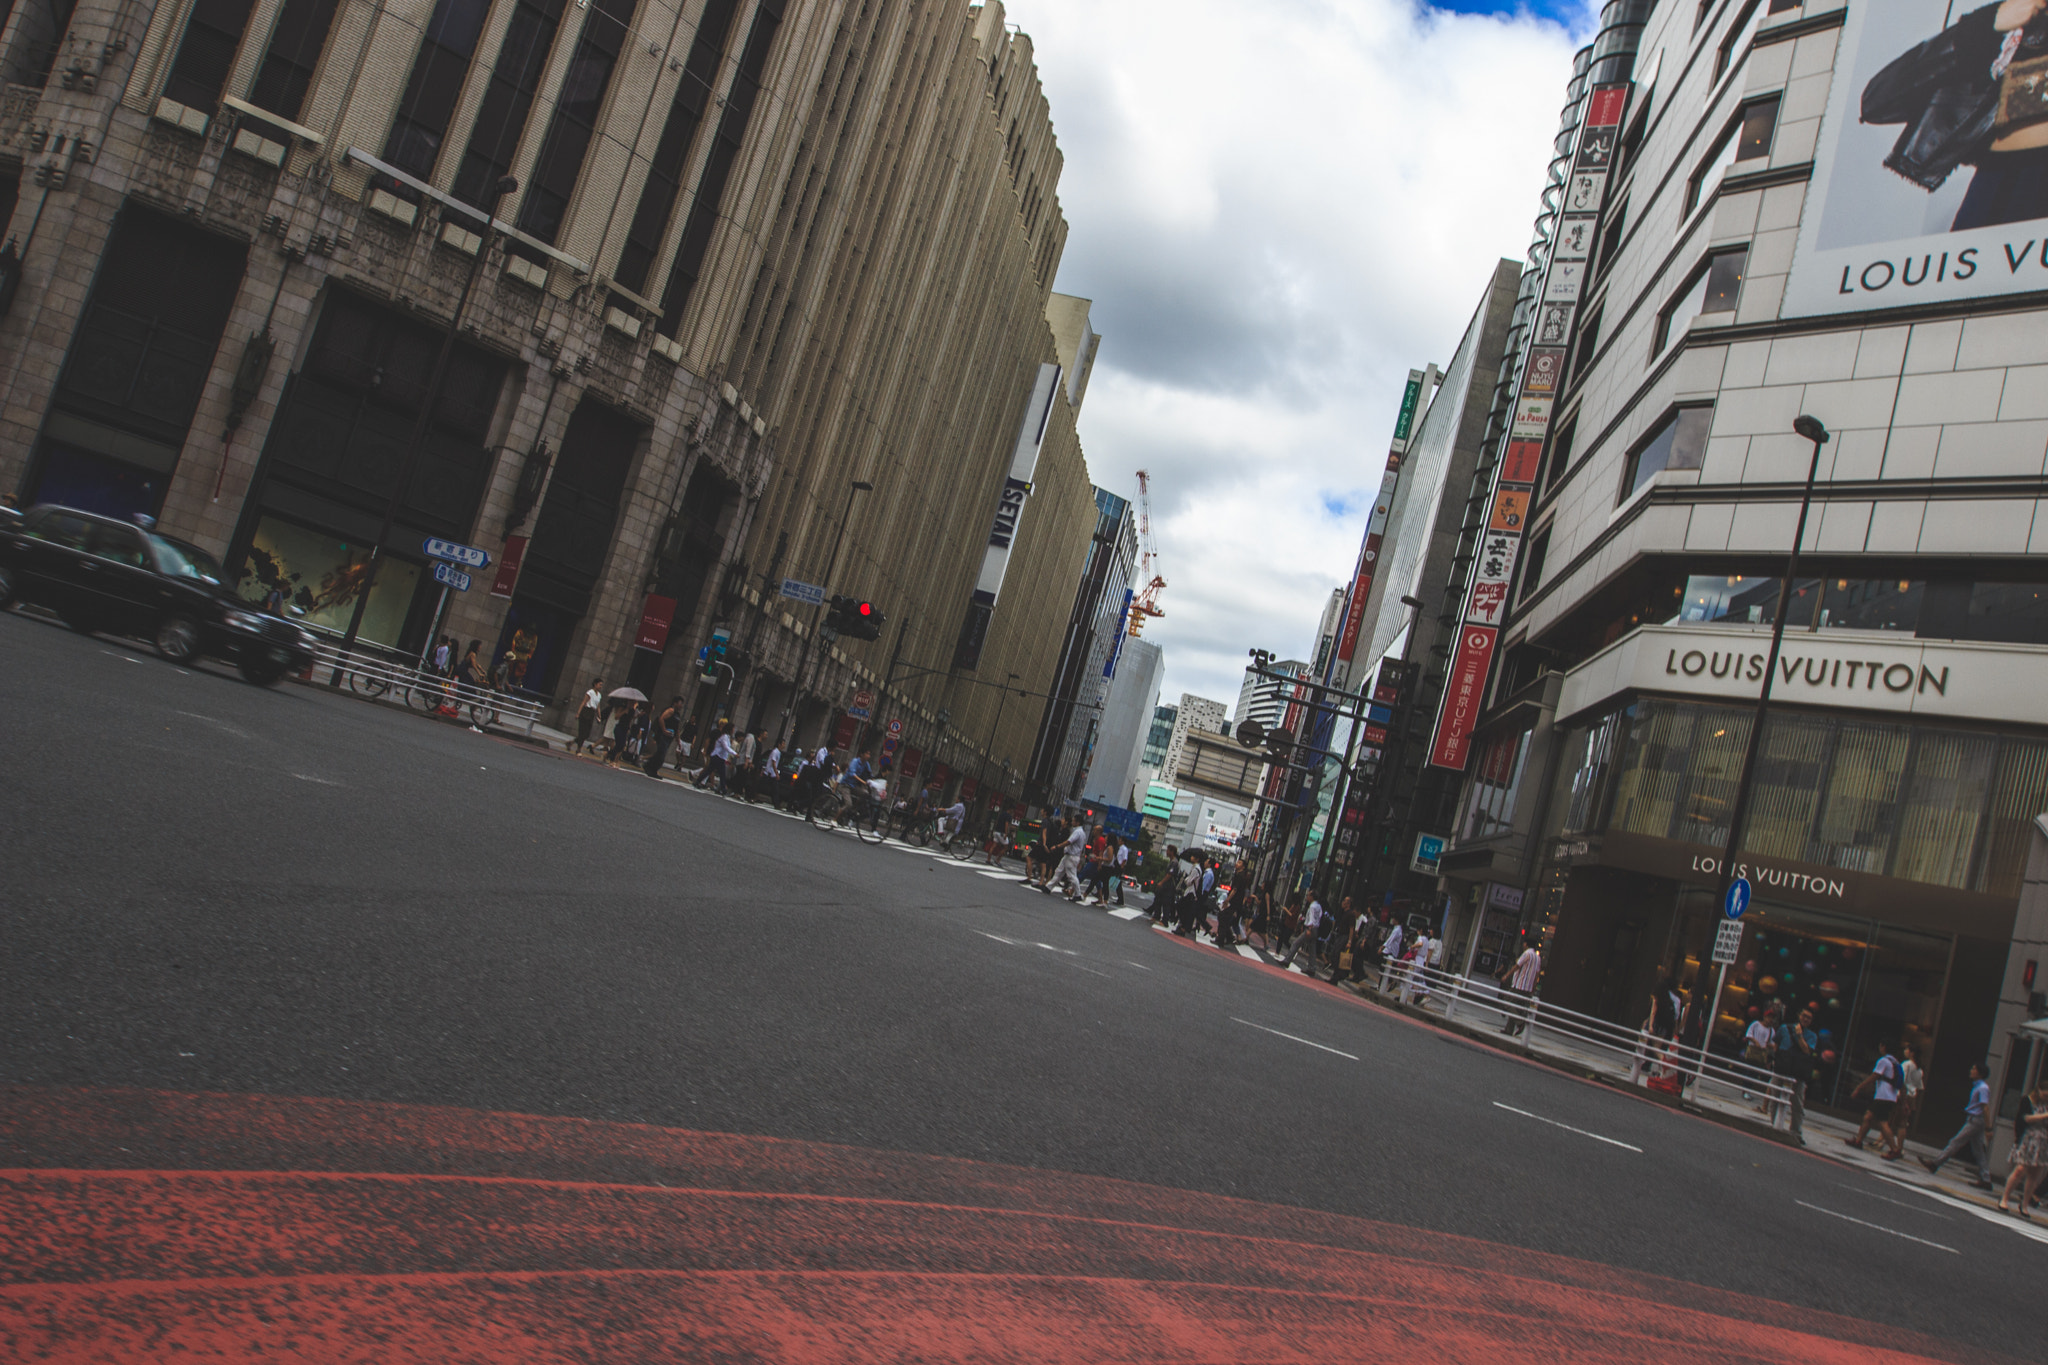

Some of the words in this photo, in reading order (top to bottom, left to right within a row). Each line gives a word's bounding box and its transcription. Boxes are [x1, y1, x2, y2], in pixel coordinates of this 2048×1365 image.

[1574, 176, 1593, 209] ねぎし
[1839, 247, 1979, 294] LOUIS
[1529, 378, 1553, 386] MARU
[1517, 413, 1525, 422] La
[1527, 413, 1548, 423] Pausa
[989, 476, 1032, 549] ISETAN
[784, 581, 823, 598] 新宿三丁目
[1666, 649, 1765, 682] LOUIS
[1781, 656, 1949, 697] VUITTON
[1444, 660, 1478, 761] 三菱東京UFJ銀行
[1756, 866, 1845, 898] VUITTON
